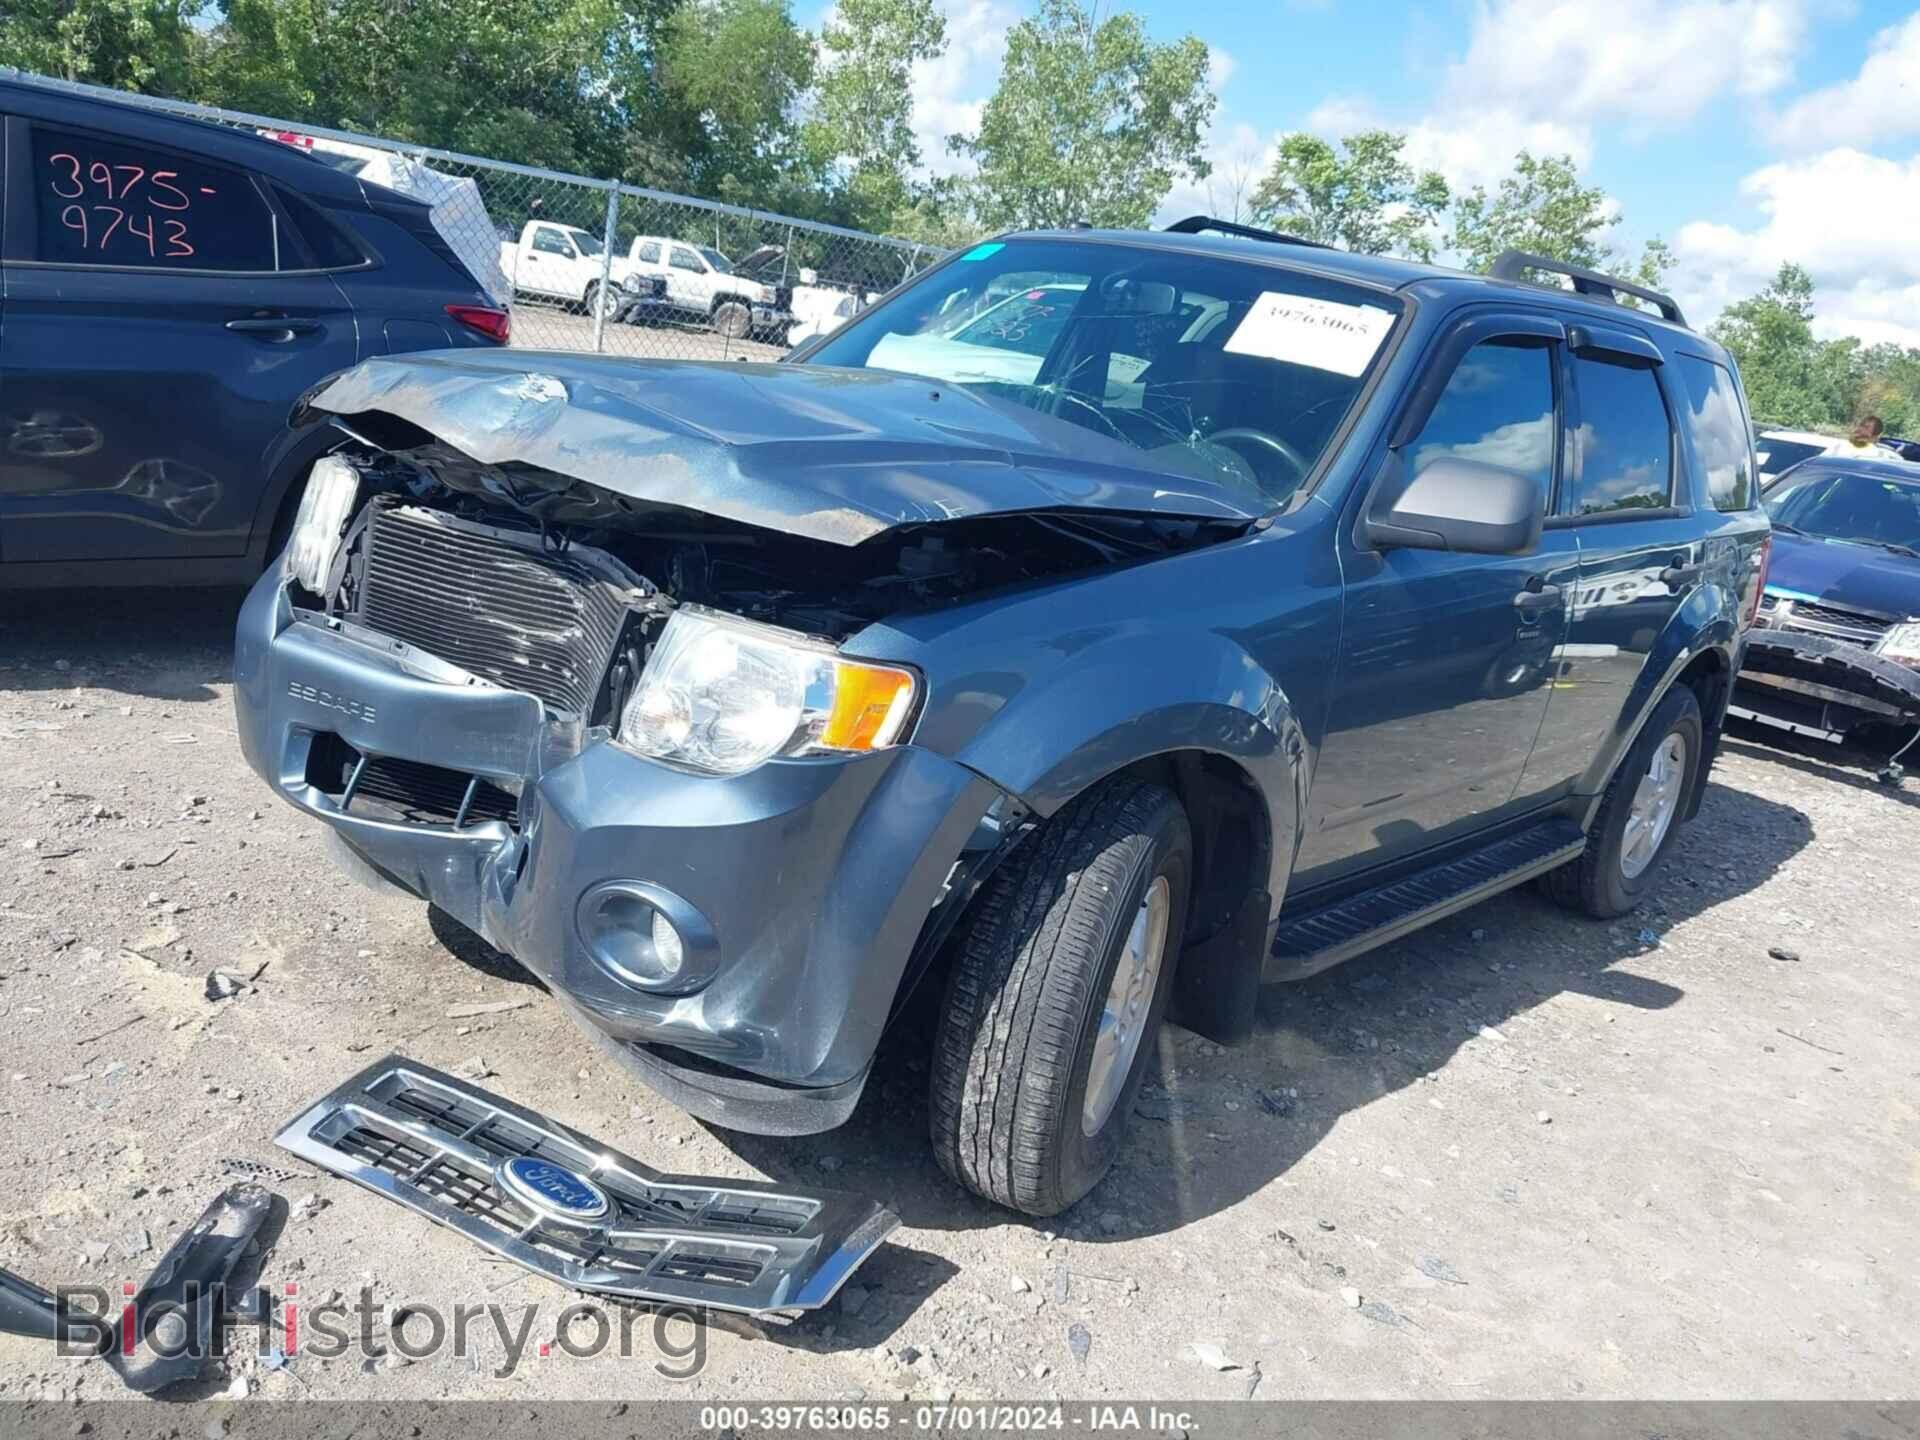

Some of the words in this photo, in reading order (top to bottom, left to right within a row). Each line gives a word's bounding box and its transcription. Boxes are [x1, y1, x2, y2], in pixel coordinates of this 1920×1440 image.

[62, 205, 194, 257] 9743
[288, 681, 377, 724] ESCAPE
[524, 1166, 587, 1202] Ford
